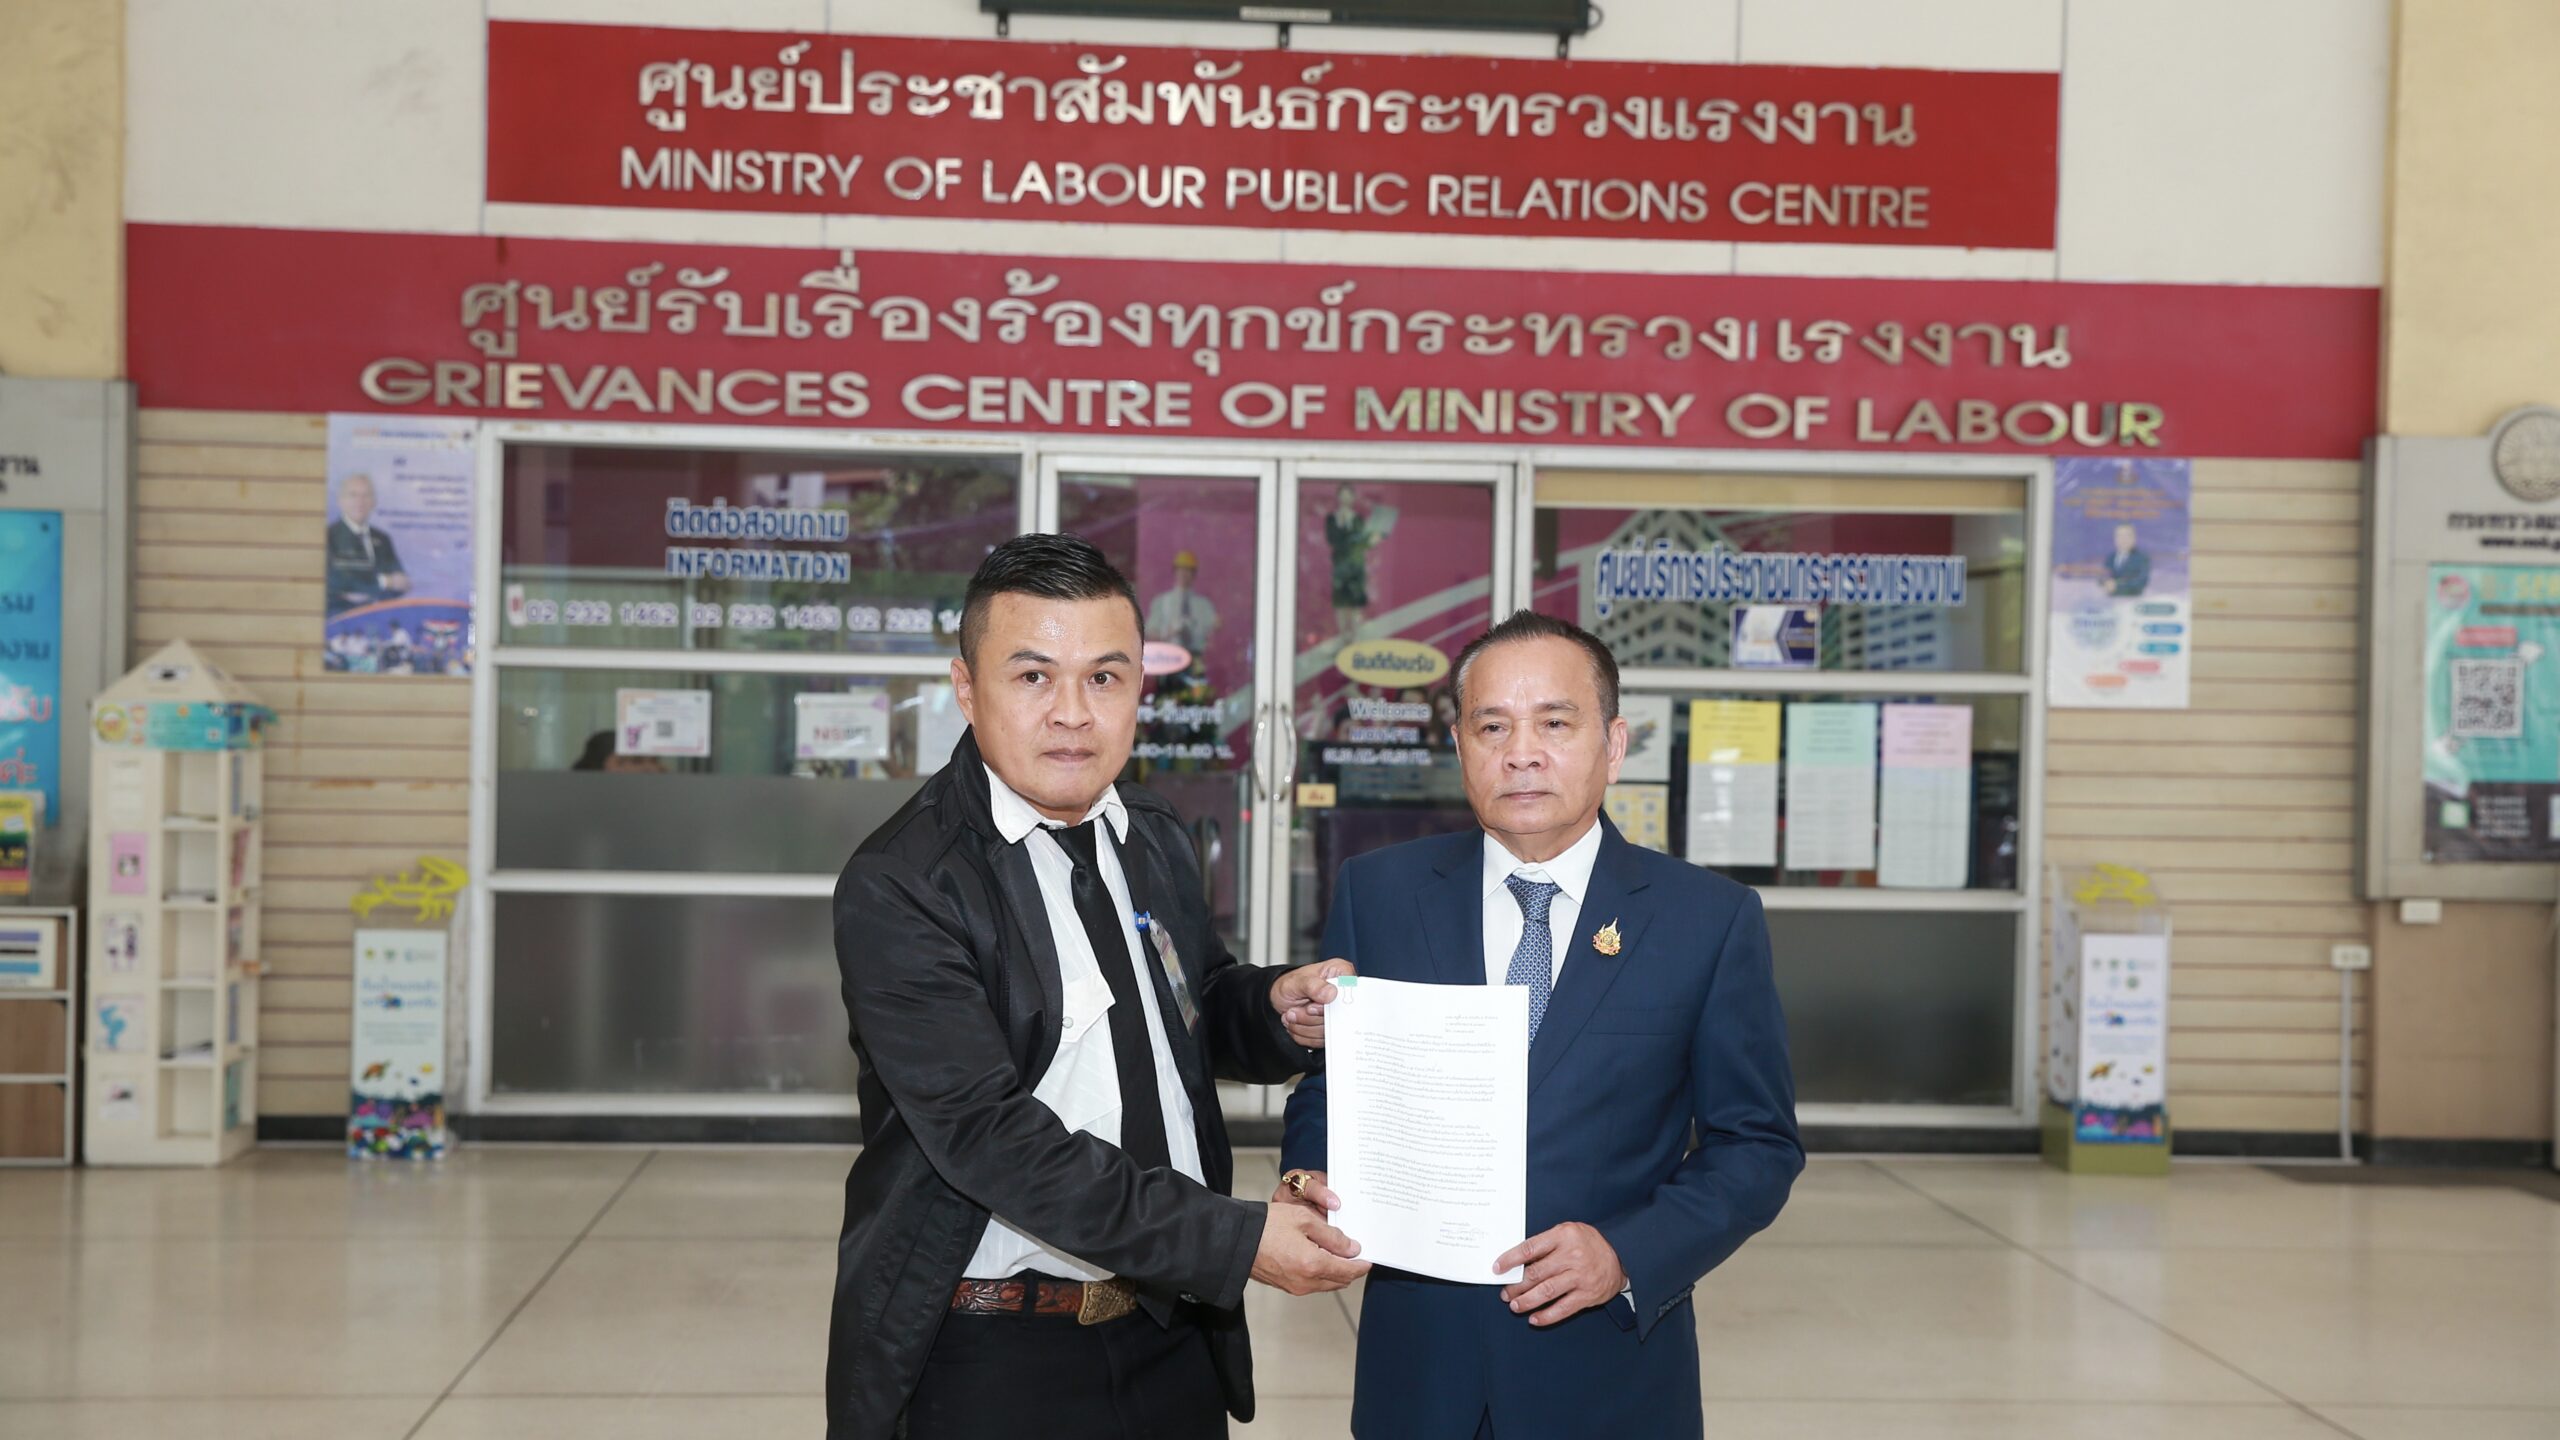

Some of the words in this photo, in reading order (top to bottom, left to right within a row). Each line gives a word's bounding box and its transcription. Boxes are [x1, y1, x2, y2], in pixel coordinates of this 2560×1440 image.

[638, 42, 1917, 147] ศูนย์ประชาสัมพันธ์กระทรวงแรงงาน
[620, 147, 863, 199] MINISTRY
[885, 157, 962, 200] OF
[982, 160, 1206, 208] LABOUR
[1225, 167, 1409, 215] PUBLIC
[1427, 175, 1708, 223] RELATIONS
[1729, 180, 1930, 228] CENTRE
[361, 357, 870, 418] GRIEVANCES
[901, 374, 1192, 427] CENTRE
[1221, 382, 1327, 430] OF
[1355, 387, 1695, 438] MINISTRY
[1726, 394, 1829, 441] OF
[1857, 399, 2163, 447] LABOUR
[666, 498, 849, 541] ติดต่อสอบถาม
[666, 548, 851, 584] INFORMATION
[526, 600, 559, 625] 02
[565, 600, 611, 626] 232
[692, 602, 723, 628] 02
[728, 603, 776, 629] 232
[847, 606, 881, 632] 02
[885, 607, 933, 633] 232
[1347, 697, 1433, 722] Welcome
